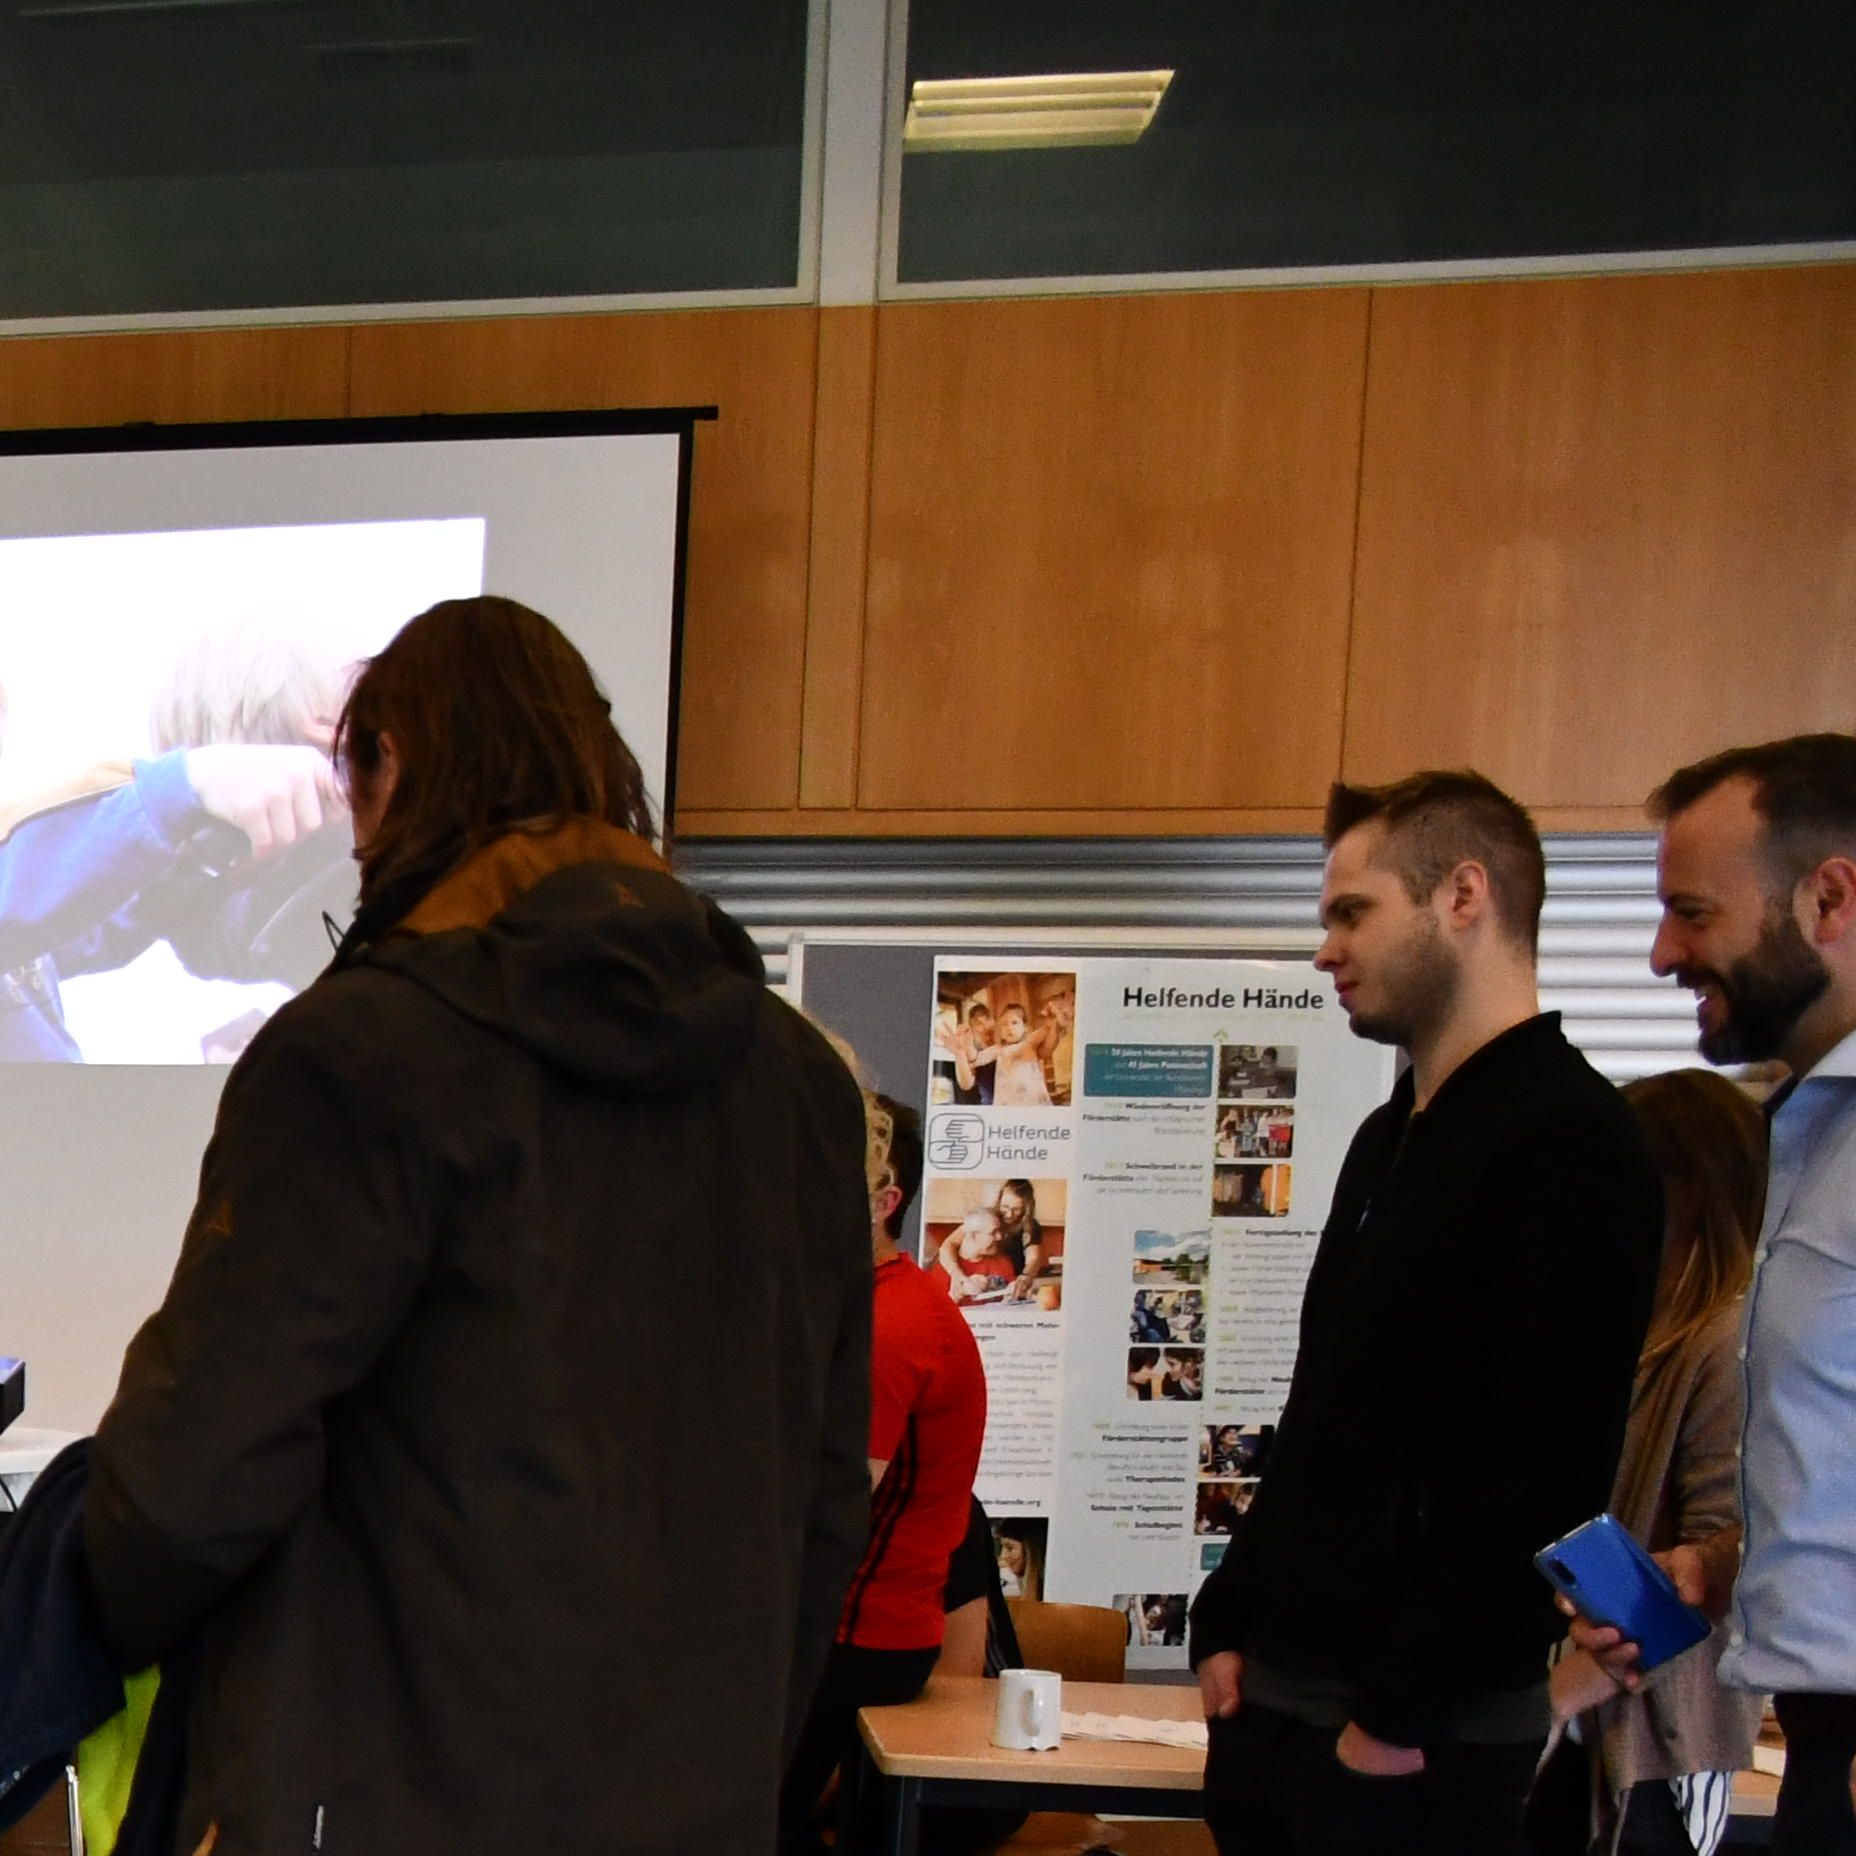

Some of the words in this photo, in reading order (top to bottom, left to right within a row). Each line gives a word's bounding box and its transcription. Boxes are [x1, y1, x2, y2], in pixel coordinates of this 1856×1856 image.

[1122, 986, 1236, 1008] Helfende
[1242, 988, 1325, 1010] Hände
[988, 1125, 1071, 1141] Helfende
[986, 1145, 1048, 1161] Hände
